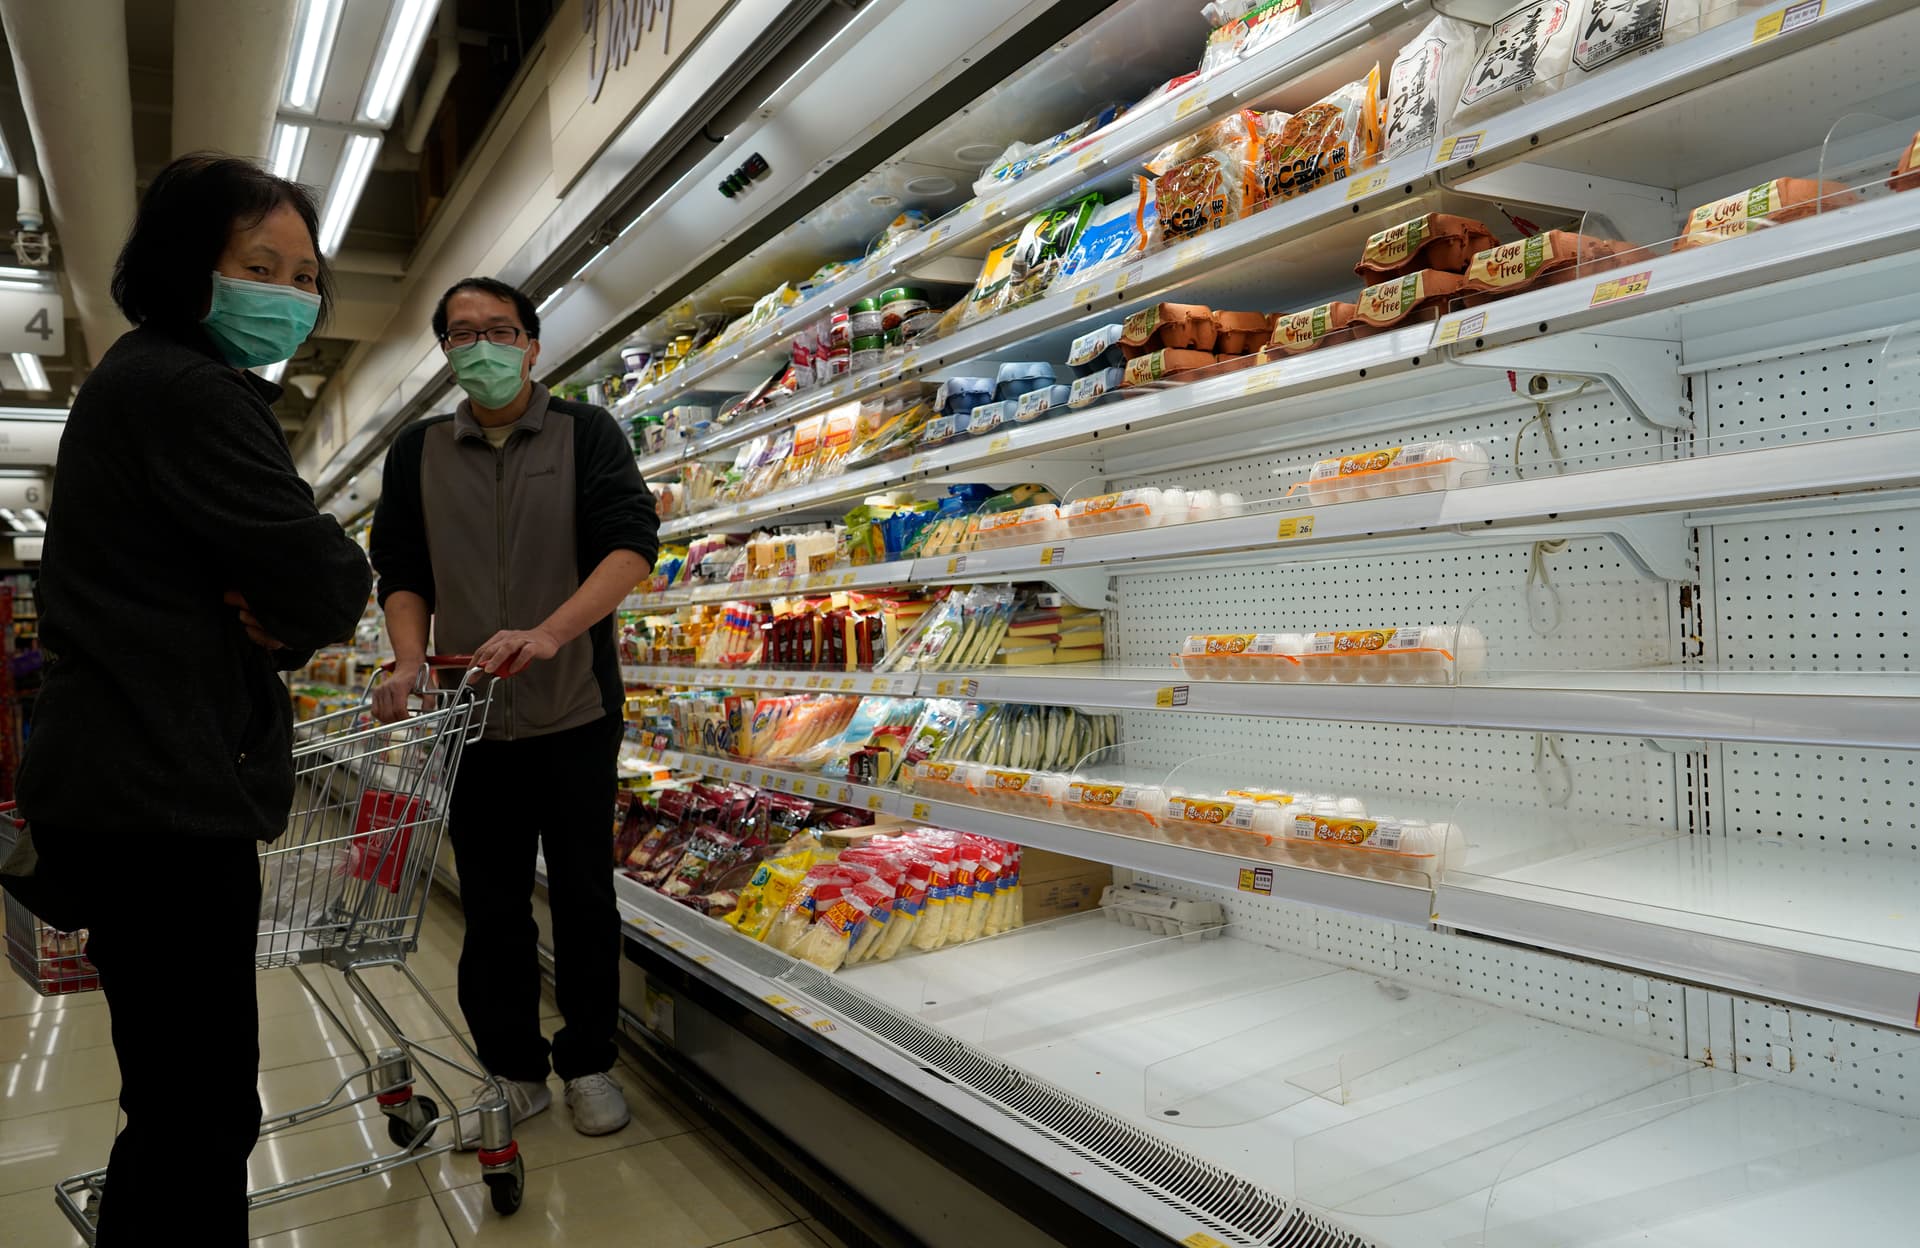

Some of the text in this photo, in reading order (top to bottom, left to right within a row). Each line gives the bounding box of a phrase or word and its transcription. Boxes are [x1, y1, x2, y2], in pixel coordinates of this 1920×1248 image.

[1714, 199, 1744, 222] Cage
[1387, 242, 1407, 257] Free
[1494, 245, 1521, 263] Cage
[1498, 261, 1524, 279] Free
[1378, 284, 1400, 300] Cage
[1380, 298, 1401, 315] Free
[24, 307, 54, 342] 4
[1291, 315, 1310, 331] Cage
[1294, 328, 1313, 343] Free
[25, 486, 39, 503] 6
